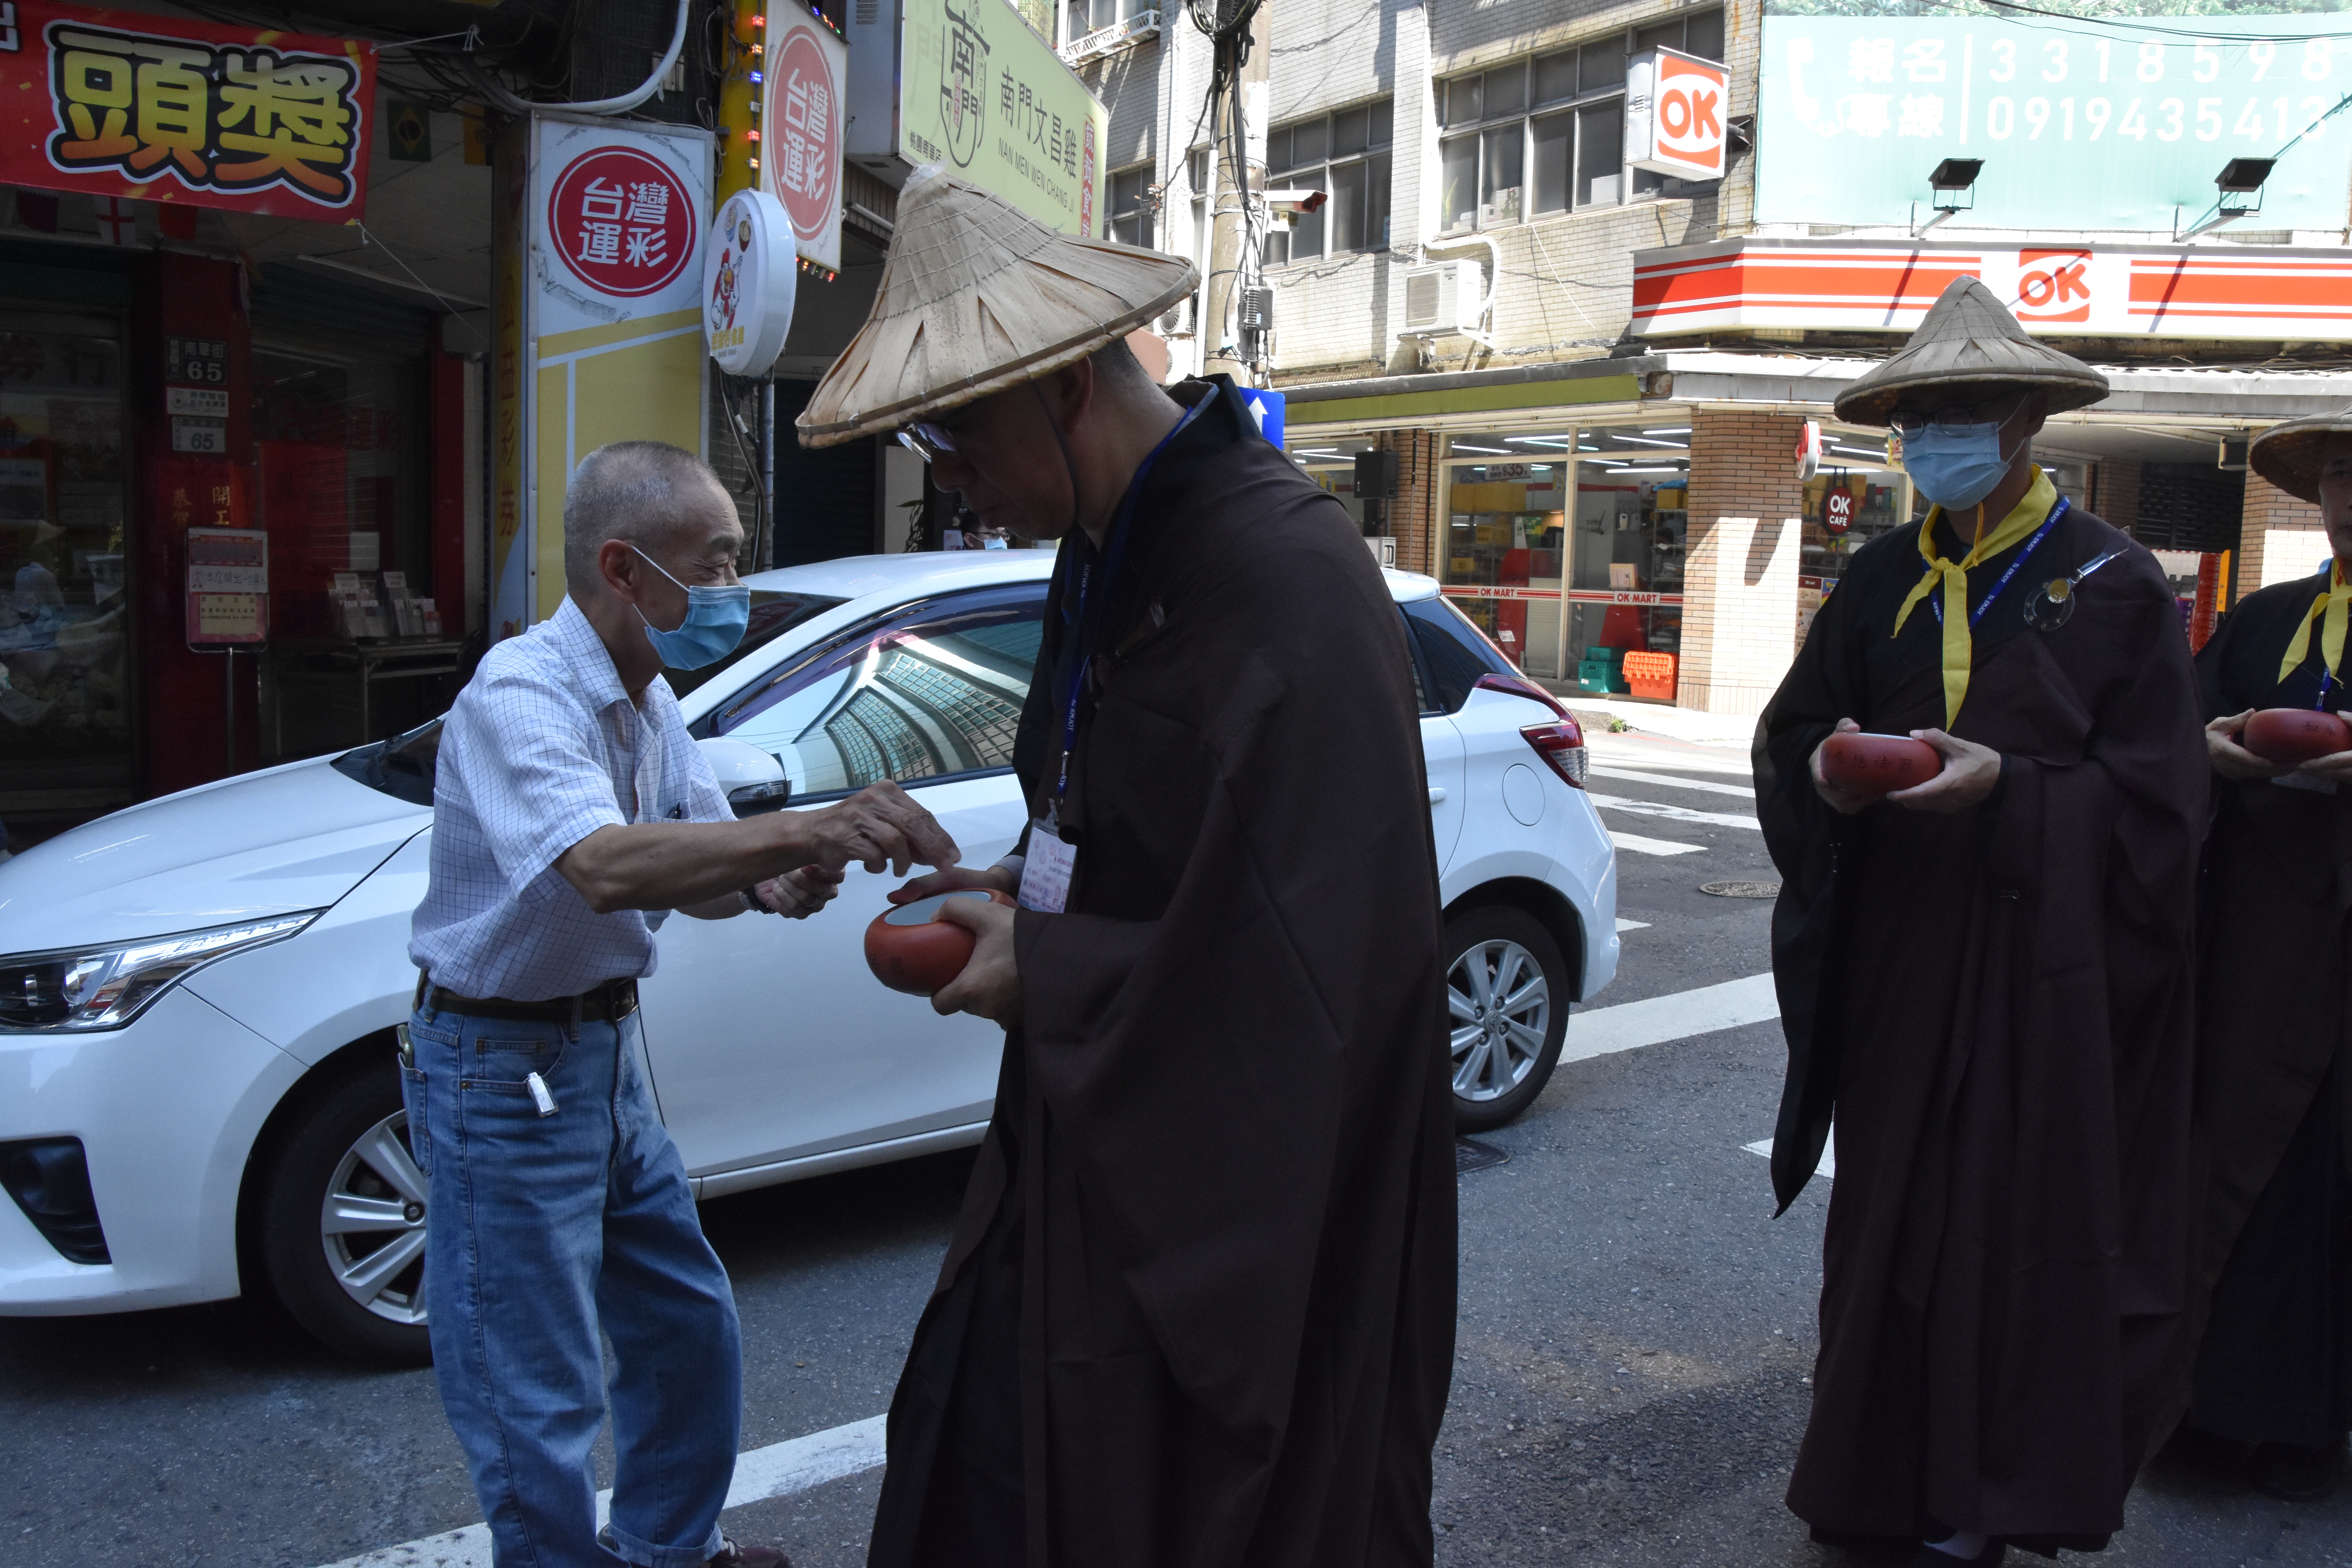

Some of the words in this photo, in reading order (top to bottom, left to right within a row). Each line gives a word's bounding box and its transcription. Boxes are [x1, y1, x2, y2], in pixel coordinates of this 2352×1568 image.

[1847, 37, 1946, 83] 報名
[1989, 38, 2333, 83] 3318598
[50, 24, 356, 202] 頭獎
[786, 68, 828, 143] 台灣
[1000, 64, 1077, 179] 南門文昌雞
[1660, 89, 1720, 140] OK
[1846, 93, 1944, 137] 專線
[1987, 96, 2327, 142] 0919435413
[781, 129, 825, 200] 運彩
[999, 138, 1013, 165] NAN
[1015, 153, 1029, 178] MEN
[1031, 166, 1045, 189] WEN
[1047, 178, 1067, 209] CHANG
[1068, 198, 1074, 214] JI
[582, 177, 670, 225] 台灣
[577, 221, 667, 267] 運彩
[2018, 263, 2091, 307] OK
[185, 341, 223, 359] 南華街
[187, 361, 222, 381] 65
[191, 433, 214, 450] 65
[212, 486, 230, 525] 開工
[1829, 515, 1848, 526] CAFÉ
[1830, 495, 1851, 515] OK
[2049, 510, 2061, 524] ENJOY
[2026, 537, 2039, 552] ENJOY
[1082, 563, 1091, 588] ENJOY
[2001, 568, 2014, 583] ENJOY
[1977, 600, 1990, 615] ENJOY
